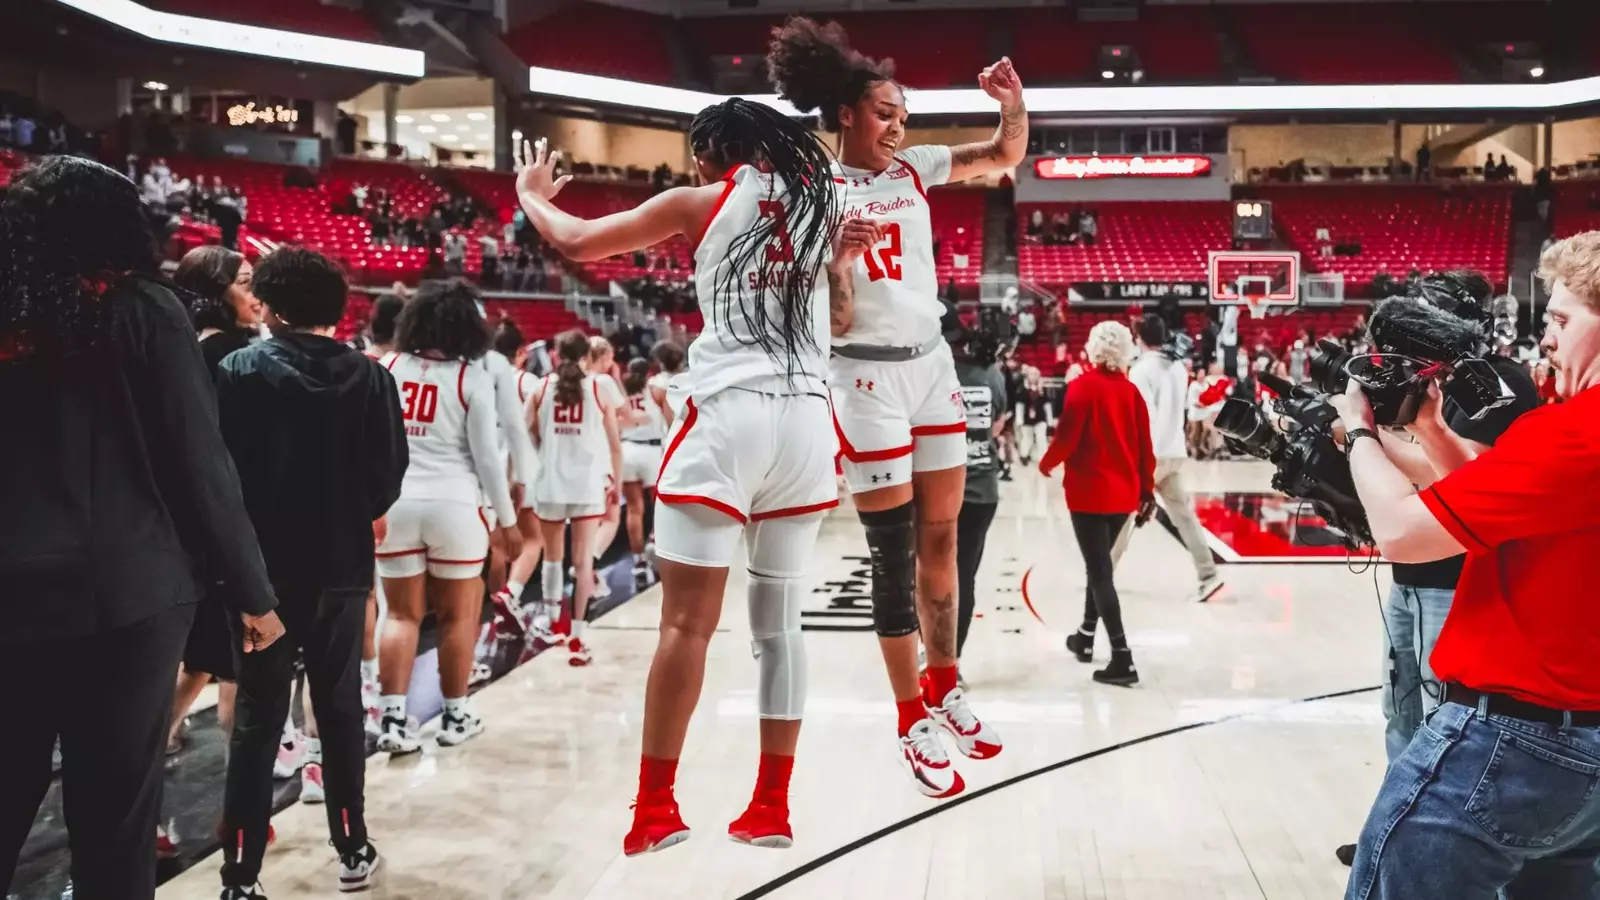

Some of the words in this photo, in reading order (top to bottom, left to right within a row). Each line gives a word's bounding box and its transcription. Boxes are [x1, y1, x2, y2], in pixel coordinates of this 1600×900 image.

[865, 196, 916, 216] Raiders
[758, 200, 795, 262] 3
[863, 222, 902, 282] 12
[402, 381, 438, 424] 30
[554, 400, 583, 424] 20
